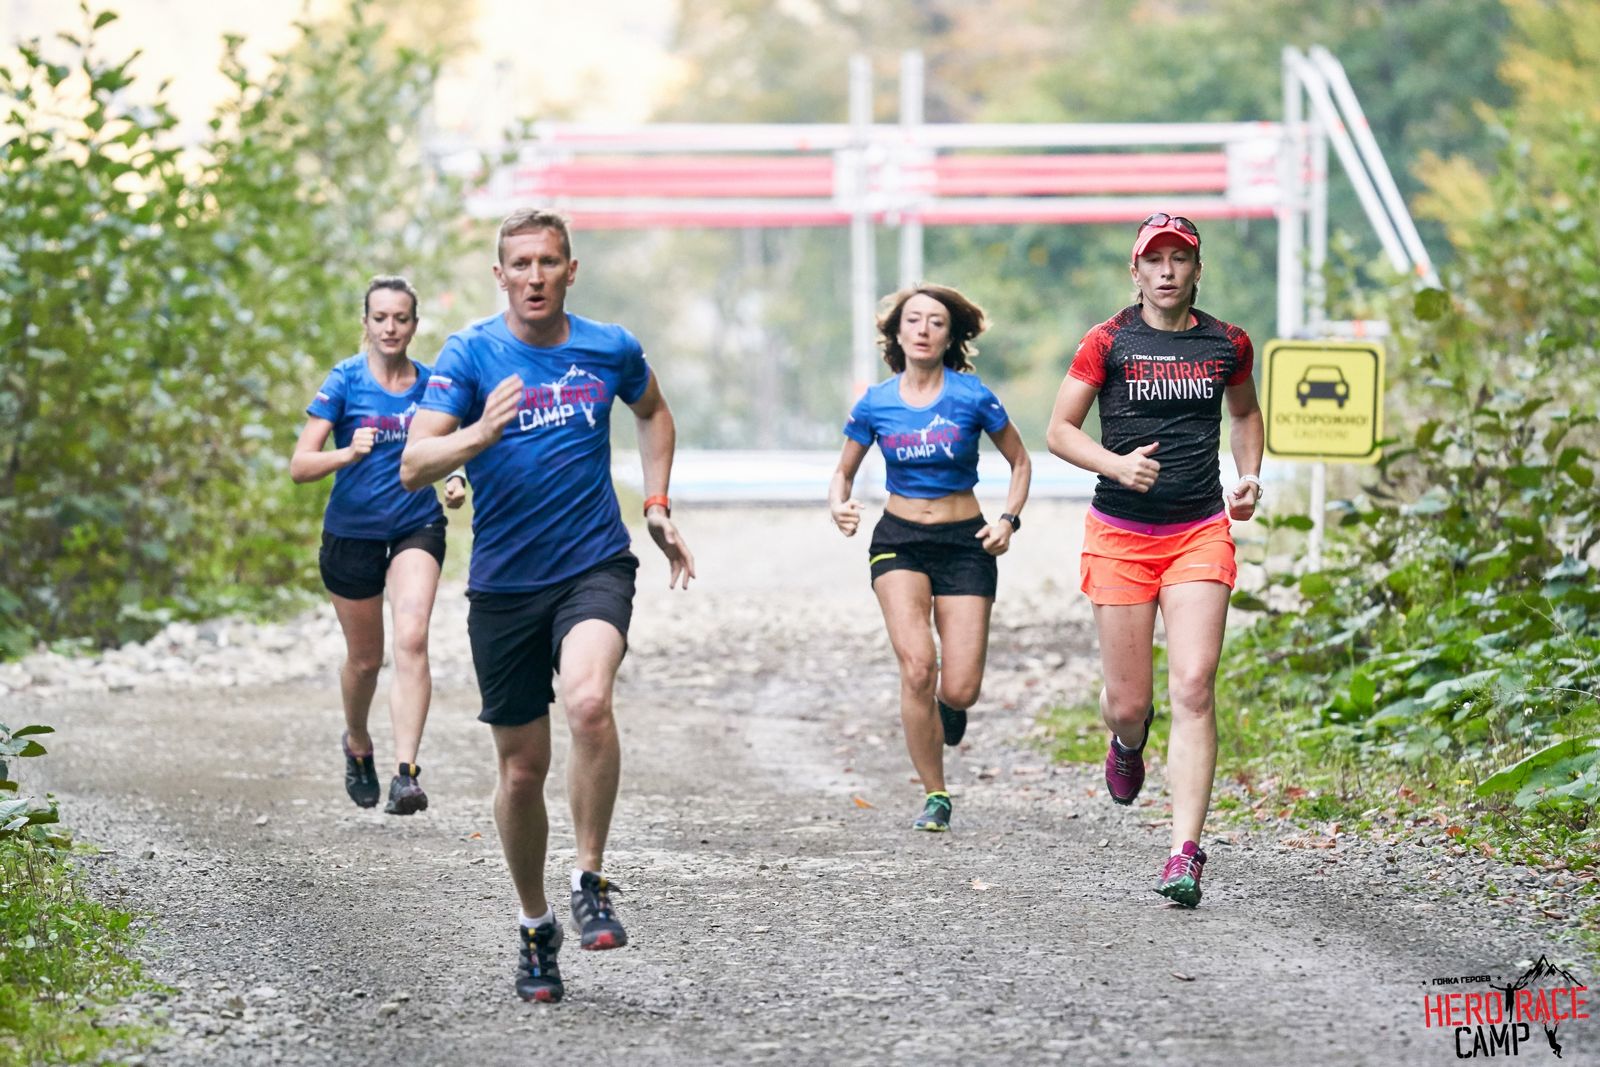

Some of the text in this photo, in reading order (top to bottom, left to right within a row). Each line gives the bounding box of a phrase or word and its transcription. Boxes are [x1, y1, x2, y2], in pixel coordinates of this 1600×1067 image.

[561, 381, 608, 406] RACE
[1126, 378, 1213, 401] TRAINING
[519, 404, 575, 431] CAMP
[896, 444, 936, 461] CAMP
